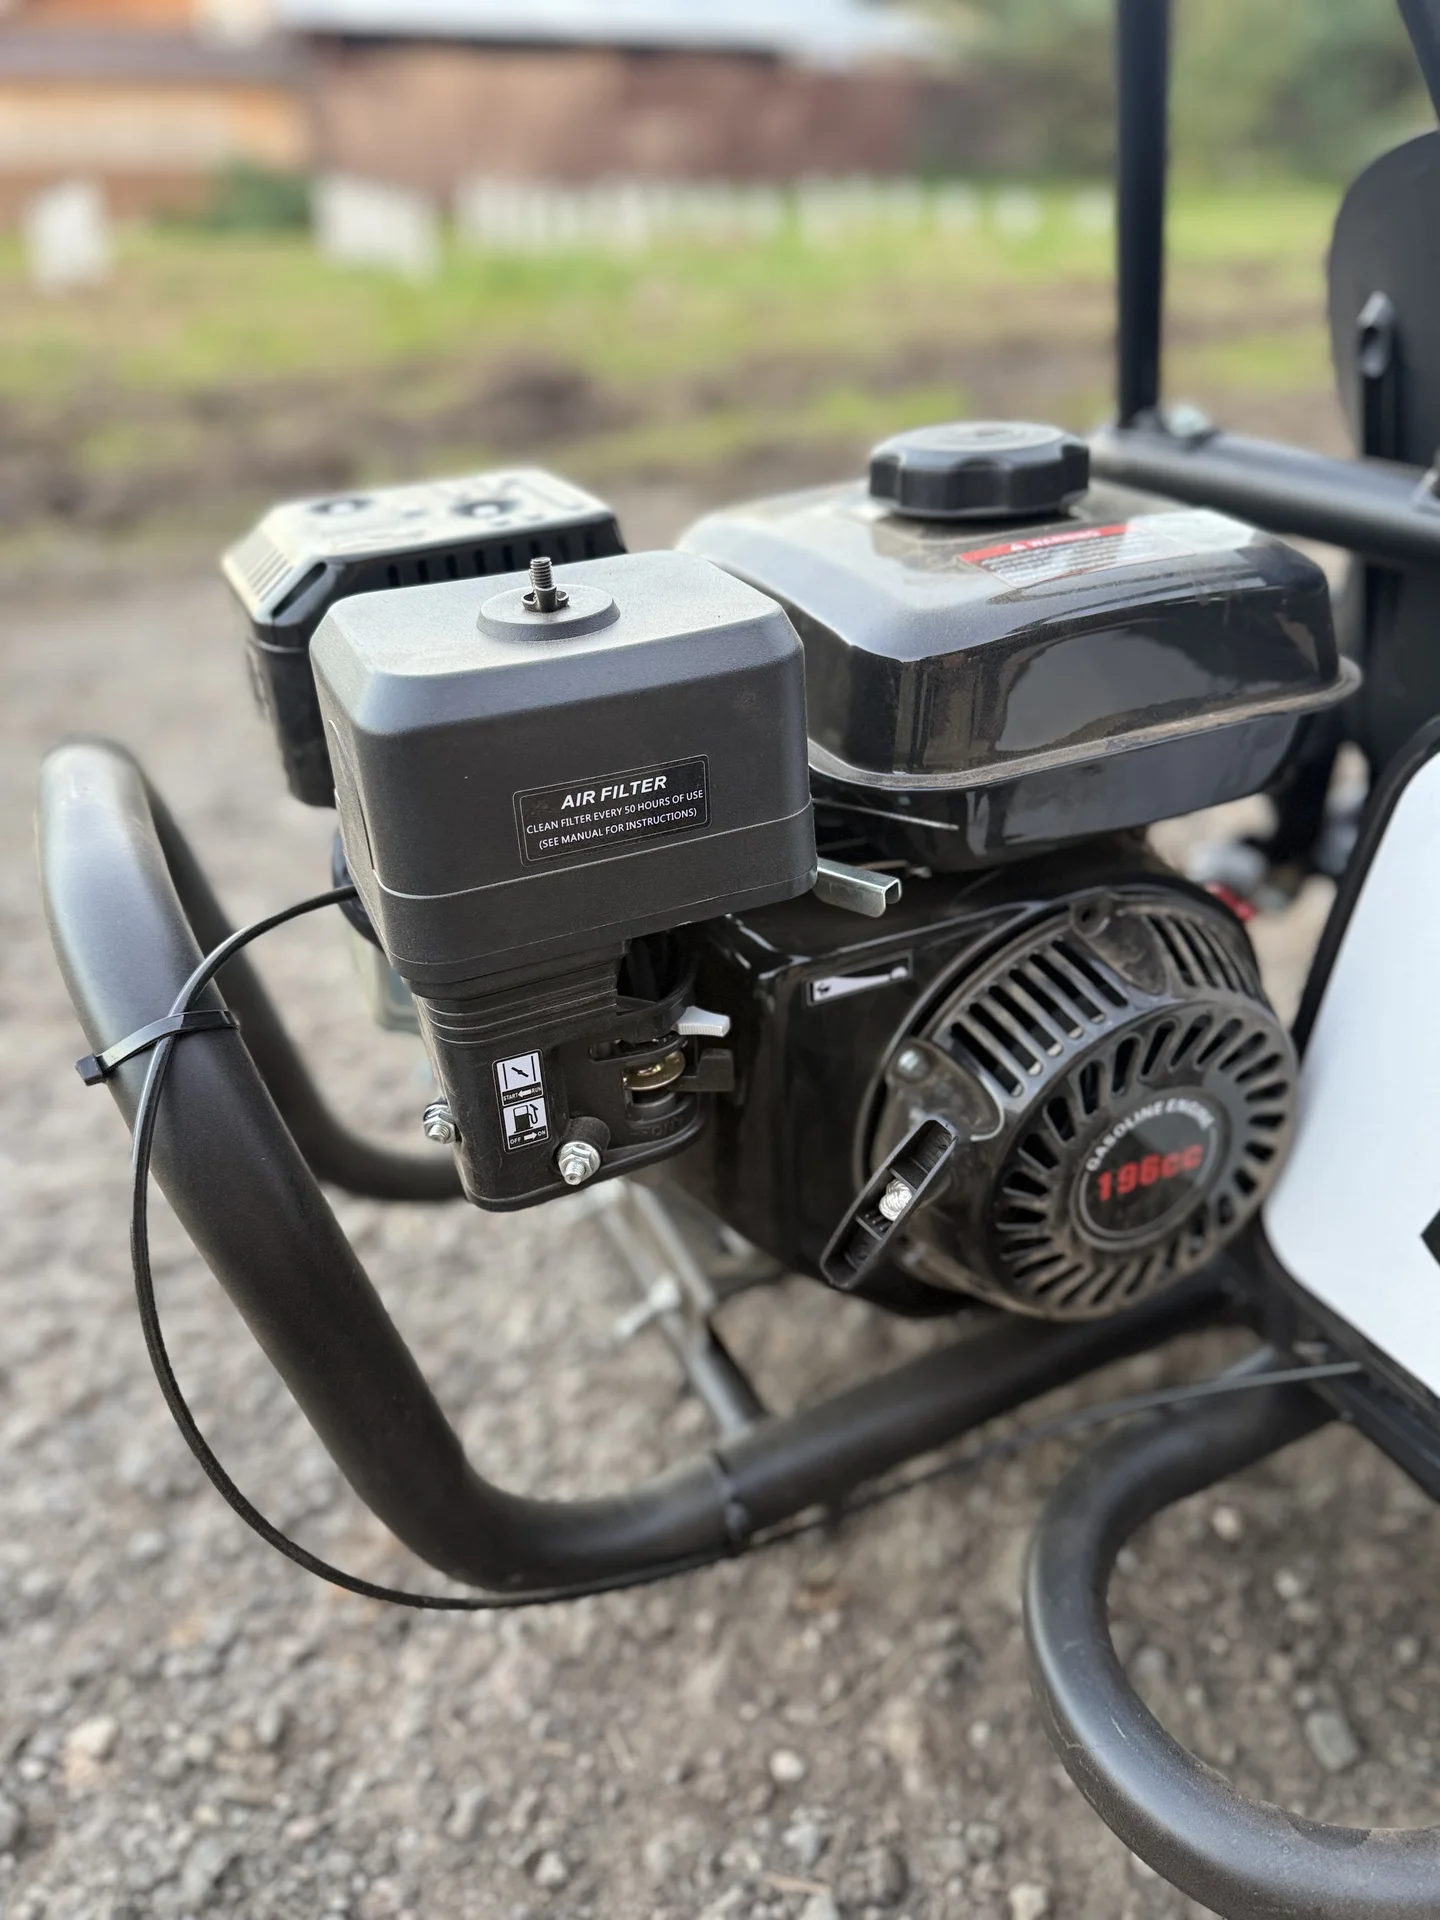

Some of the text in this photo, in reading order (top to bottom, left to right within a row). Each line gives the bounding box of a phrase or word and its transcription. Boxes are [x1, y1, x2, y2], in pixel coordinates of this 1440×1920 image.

[526, 789, 704, 834] CLEAN FILTER EVERY 50 HOURS OF USE
[561, 775, 667, 810] AIR FILTER
[539, 807, 697, 850] (SEE MANUAL FOR INSTRUCTIONS)
[503, 1086, 542, 1102] START RUN
[509, 1129, 546, 1145] OFF ON
[1085, 1099, 1165, 1172] GASOLINE
[1097, 1144, 1204, 1202] 196cc
